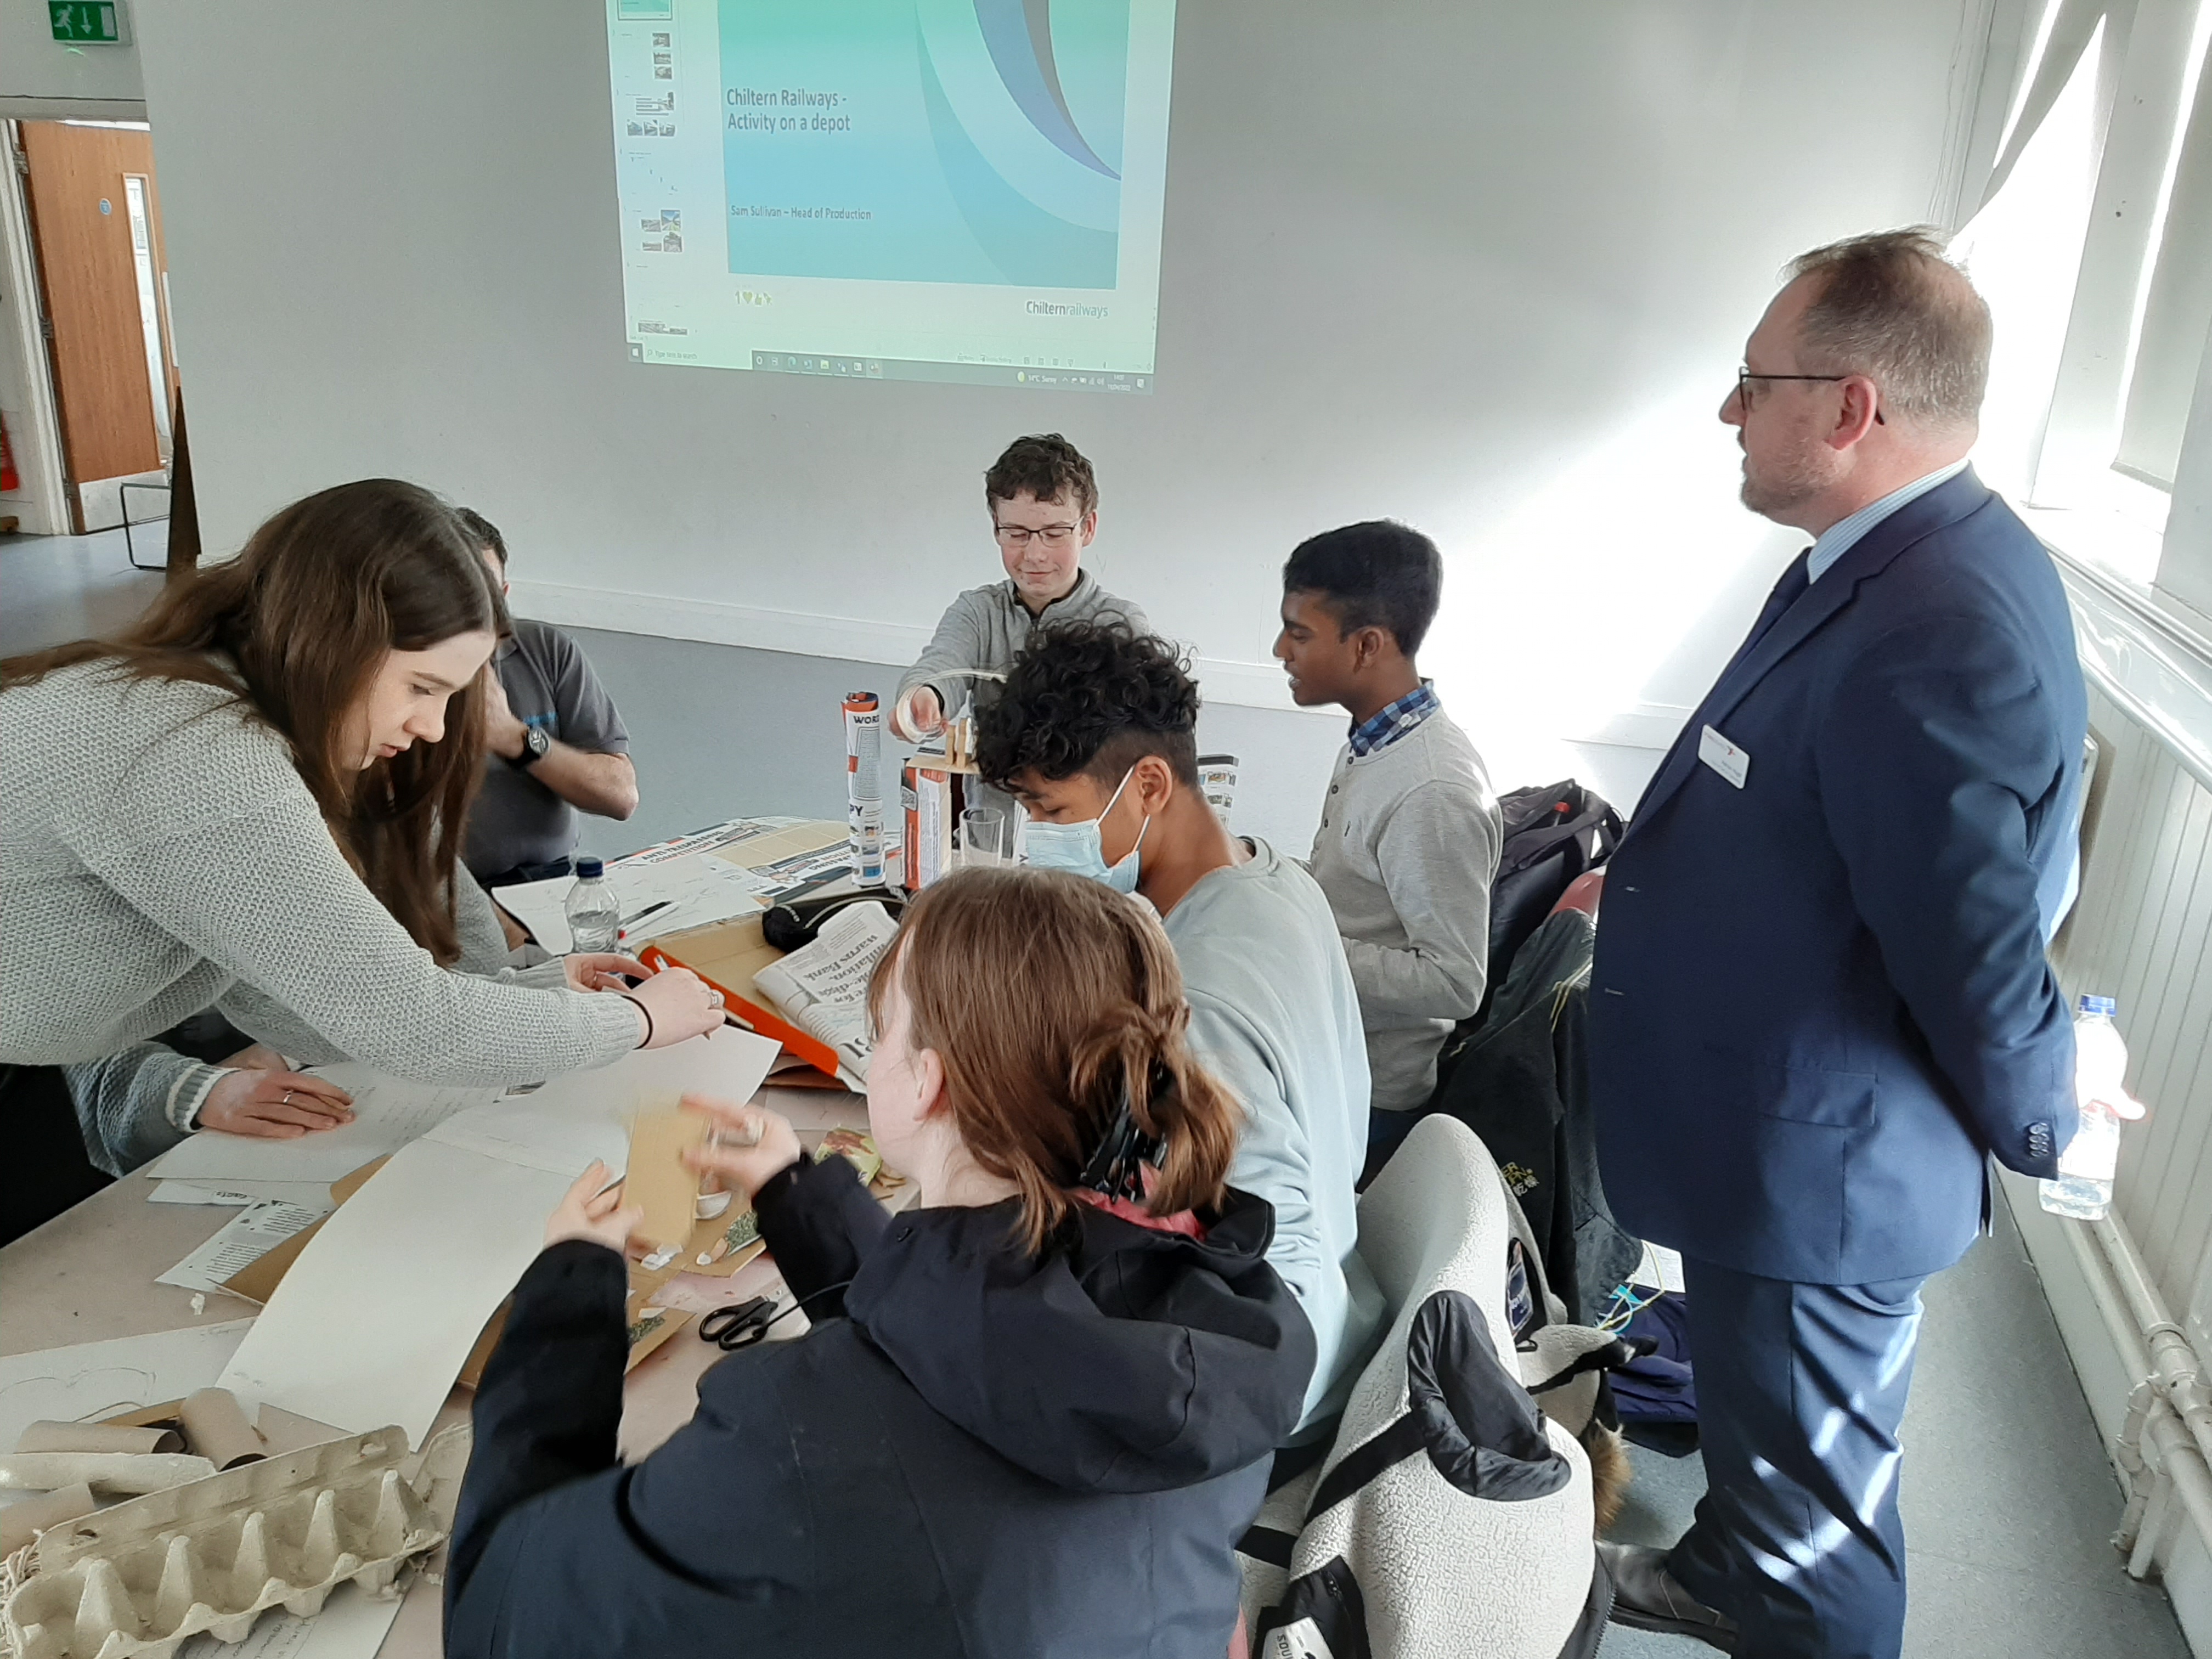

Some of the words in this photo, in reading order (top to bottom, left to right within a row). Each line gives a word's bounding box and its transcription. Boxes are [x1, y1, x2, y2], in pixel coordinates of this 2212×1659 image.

[727, 88, 777, 106] Chiltern
[781, 88, 838, 110] Railways
[727, 112, 776, 134] Activity
[780, 117, 796, 130] on
[799, 117, 807, 130] a
[811, 112, 850, 135] depot
[731, 205, 748, 216] Sam
[751, 206, 781, 217] Sullivan
[791, 207, 812, 218] Head
[815, 207, 823, 218] of
[826, 207, 871, 220] Production
[840, 934, 878, 964] warns
[803, 961, 842, 981] Bank
